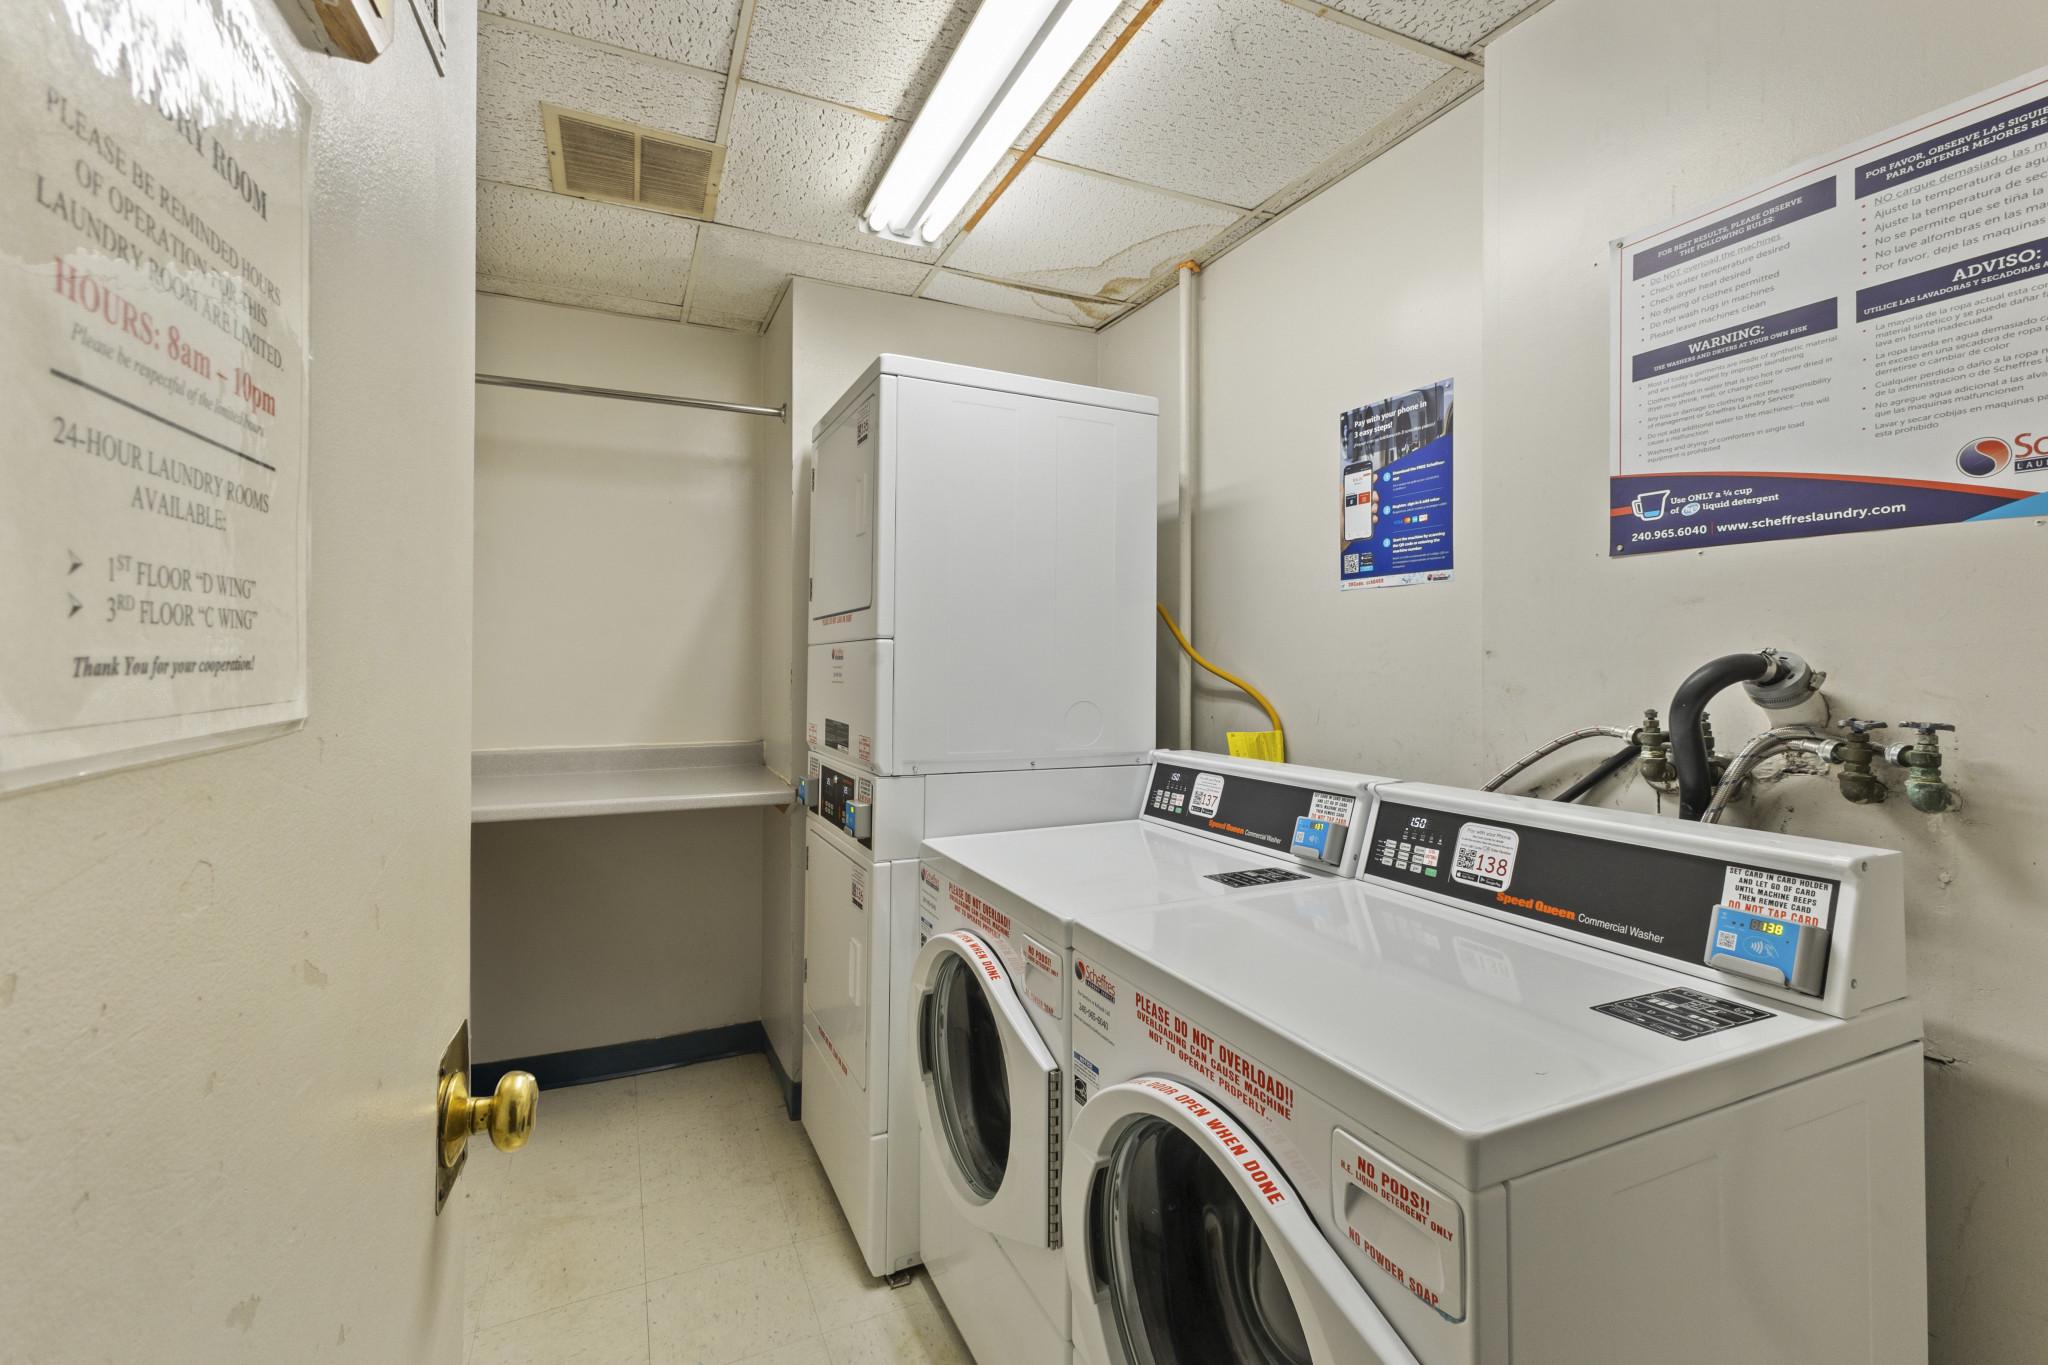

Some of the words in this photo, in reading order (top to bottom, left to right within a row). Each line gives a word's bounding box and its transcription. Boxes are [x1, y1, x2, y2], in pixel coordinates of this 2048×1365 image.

[1865, 164, 1887, 179] POR
[1928, 131, 1980, 157] OBSERVE
[1983, 121, 2006, 138] LAS
[1886, 164, 1914, 180] PARA
[1917, 145, 1970, 170] OBTENER
[1972, 124, 2028, 151] MEJORES
[47, 86, 126, 175] PLEASE
[132, 161, 154, 200] BE
[160, 184, 238, 269] REMINDED
[242, 257, 280, 307] HOURS
[213, 137, 267, 222] ROOM
[1874, 198, 1908, 218] Ajuste
[1911, 194, 1922, 206] la
[1925, 169, 2001, 201] temperatura
[2005, 162, 2022, 174] de
[75, 159, 103, 197] OF
[108, 186, 206, 275] OPERATION
[242, 289, 267, 327] THIS
[1658, 246, 1673, 258] FOR
[1674, 238, 1693, 252] BEST
[1731, 213, 1761, 230] PLEASE
[1762, 197, 1803, 218] OBSERVE
[1680, 246, 1695, 257] THE
[1696, 228, 1745, 251] FOLLOWING
[1746, 217, 1775, 233] RULES:
[1875, 246, 1891, 259] No
[1895, 238, 1917, 253] lave
[1921, 218, 1981, 245] alfombras
[1984, 212, 2000, 225] en
[2004, 205, 2022, 219] las
[37, 174, 142, 271] LAUNDRY
[149, 256, 198, 312] ROOM
[202, 297, 231, 334] ARE
[234, 318, 284, 372] LIMITED.
[1952, 249, 2041, 282] ADVISO:
[1863, 300, 1899, 316] UTILICE
[1899, 295, 1916, 306] LAS
[1917, 281, 1971, 302] LAVADORAS
[1972, 278, 1980, 287] Y
[1981, 262, 2041, 285] SECADORAS
[55, 255, 160, 350] HOURS:
[168, 325, 211, 380] 8am
[234, 367, 276, 417] 10pm
[1688, 325, 1765, 354] WARNING:
[1354, 420, 1366, 428] Pay
[1366, 415, 1380, 424] with
[1381, 410, 1396, 420] your
[1397, 403, 1419, 416] phone
[1419, 400, 1427, 409] in
[1358, 429, 1373, 438] easy
[1374, 421, 1393, 432] steps!
[53, 416, 143, 472] 24-HOUR
[147, 451, 223, 498] LAUNDRY
[226, 480, 269, 514] ROOMS
[131, 485, 227, 532] AVAILABLE:
[1670, 506, 1679, 515] of
[1702, 500, 1730, 511] liquid
[1731, 493, 1780, 508] detergent
[1671, 495, 1687, 505] Use
[1688, 492, 1713, 503] ONLY
[1734, 487, 1753, 498] cup
[1631, 524, 1708, 542] 240.965.6040
[1716, 502, 1907, 534] www.scheffreslaundry.com
[136, 562, 192, 592] FLOOR
[140, 600, 195, 626] FLOOR
[73, 656, 120, 679] Thank
[123, 656, 148, 676] You
[148, 655, 170, 680] for
[170, 661, 197, 679] your
[198, 655, 256, 677] cooperation!
[1202, 793, 1218, 808] 137
[1209, 819, 1226, 831] Speed
[1226, 823, 1244, 834] Queen
[1244, 829, 1267, 841] Commercial
[1267, 833, 1282, 844] Washer
[1475, 854, 1508, 877] 138
[1744, 870, 1764, 879] CARD
[1766, 873, 1775, 881] IN
[1776, 875, 1797, 885] CARD
[1799, 878, 1829, 891] HOLDER
[972, 896, 982, 910] NOT
[1735, 885, 1755, 896] UNTIL
[1757, 889, 1790, 901] MACHINE
[1792, 894, 1817, 906] BEEPS
[1738, 877, 1753, 886] AND
[1755, 879, 1769, 888] LET
[1770, 882, 1781, 890] GO
[1783, 884, 1793, 892] OF
[1795, 886, 1816, 897] CARD
[1738, 893, 1757, 903] THEN
[1759, 897, 1788, 908] REMOVE
[1790, 903, 1812, 914] CARD
[1496, 891, 1534, 911] Speed
[1535, 901, 1576, 920] Queen
[1578, 913, 1628, 935] Commercial
[1629, 924, 1664, 944] Washer
[1745, 903, 1764, 915] NOT
[1767, 907, 1787, 919] TAP
[1791, 911, 1819, 927] CARD
[1761, 922, 1784, 936] 138
[969, 943, 988, 960] WHEN
[982, 960, 1001, 981] DONE
[1028, 945, 1035, 956] NO
[1086, 965, 1116, 997] Scheffres
[1135, 991, 1170, 1027] PLEASE
[1174, 1016, 1188, 1038] DO
[1192, 1028, 1215, 1055] NOT
[1219, 1044, 1294, 1108] OVERLOAD!!
[1136, 1010, 1187, 1050] OVERLOADING
[1190, 1044, 1207, 1063] CAN
[1211, 1058, 1240, 1087] CAUSE
[1244, 1081, 1292, 1121] MACHINE
[1148, 1030, 1163, 1046] NOT
[1166, 1042, 1176, 1055] TO
[1179, 1050, 1215, 1082] OPERATE
[1150, 1081, 1179, 1096] DOOR
[1174, 1094, 1211, 1118] OPEN
[1206, 1118, 1249, 1157] WHEN
[1243, 1159, 1285, 1205] DONE
[1355, 1169, 1379, 1193] LIQUID
[1381, 1190, 1427, 1225] DETERGENT
[1430, 1221, 1454, 1242] ONLY
[1357, 1156, 1375, 1179] NO
[1381, 1172, 1430, 1216] PODS!!
[1349, 1226, 1361, 1246] NO
[1364, 1240, 1404, 1284] POWDER
[1409, 1276, 1439, 1306] SOAP
